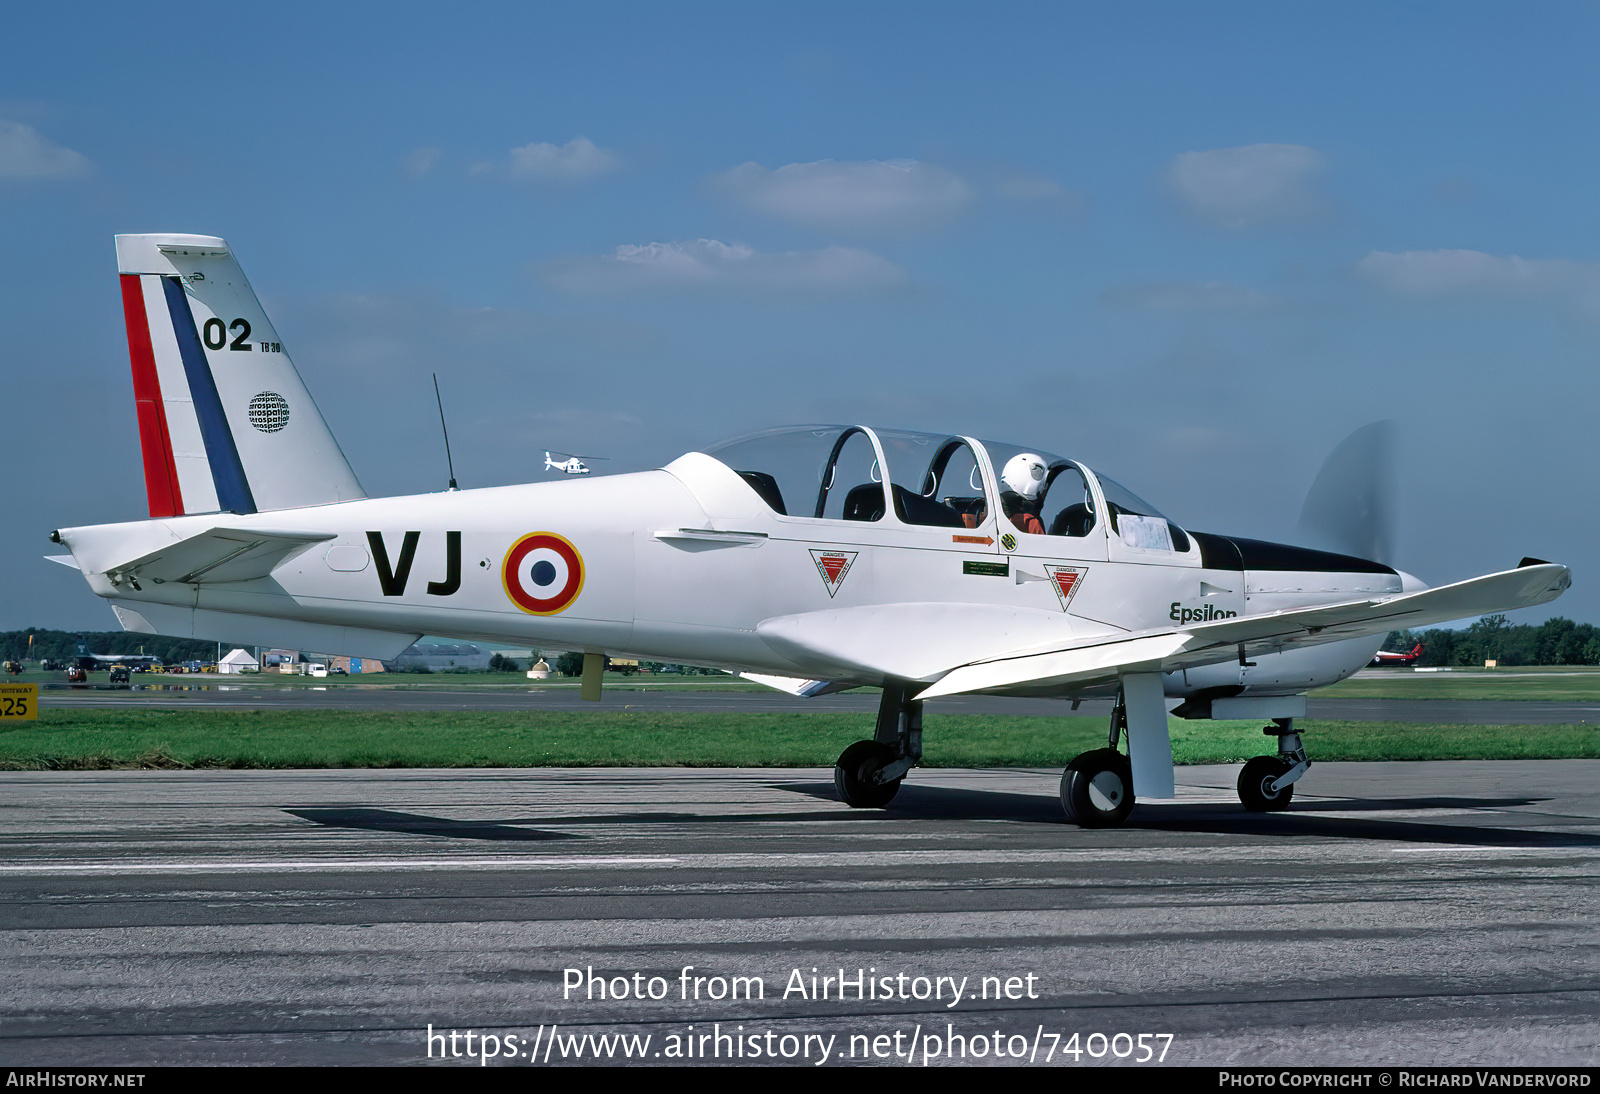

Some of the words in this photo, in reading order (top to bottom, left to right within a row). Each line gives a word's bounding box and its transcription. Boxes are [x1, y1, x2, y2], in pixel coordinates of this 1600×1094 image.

[203, 317, 252, 351] 02
[260, 342, 269, 353] TB
[365, 530, 462, 596] VJ
[1169, 602, 1238, 625] Epsilon
[0, 697, 27, 716] 25
